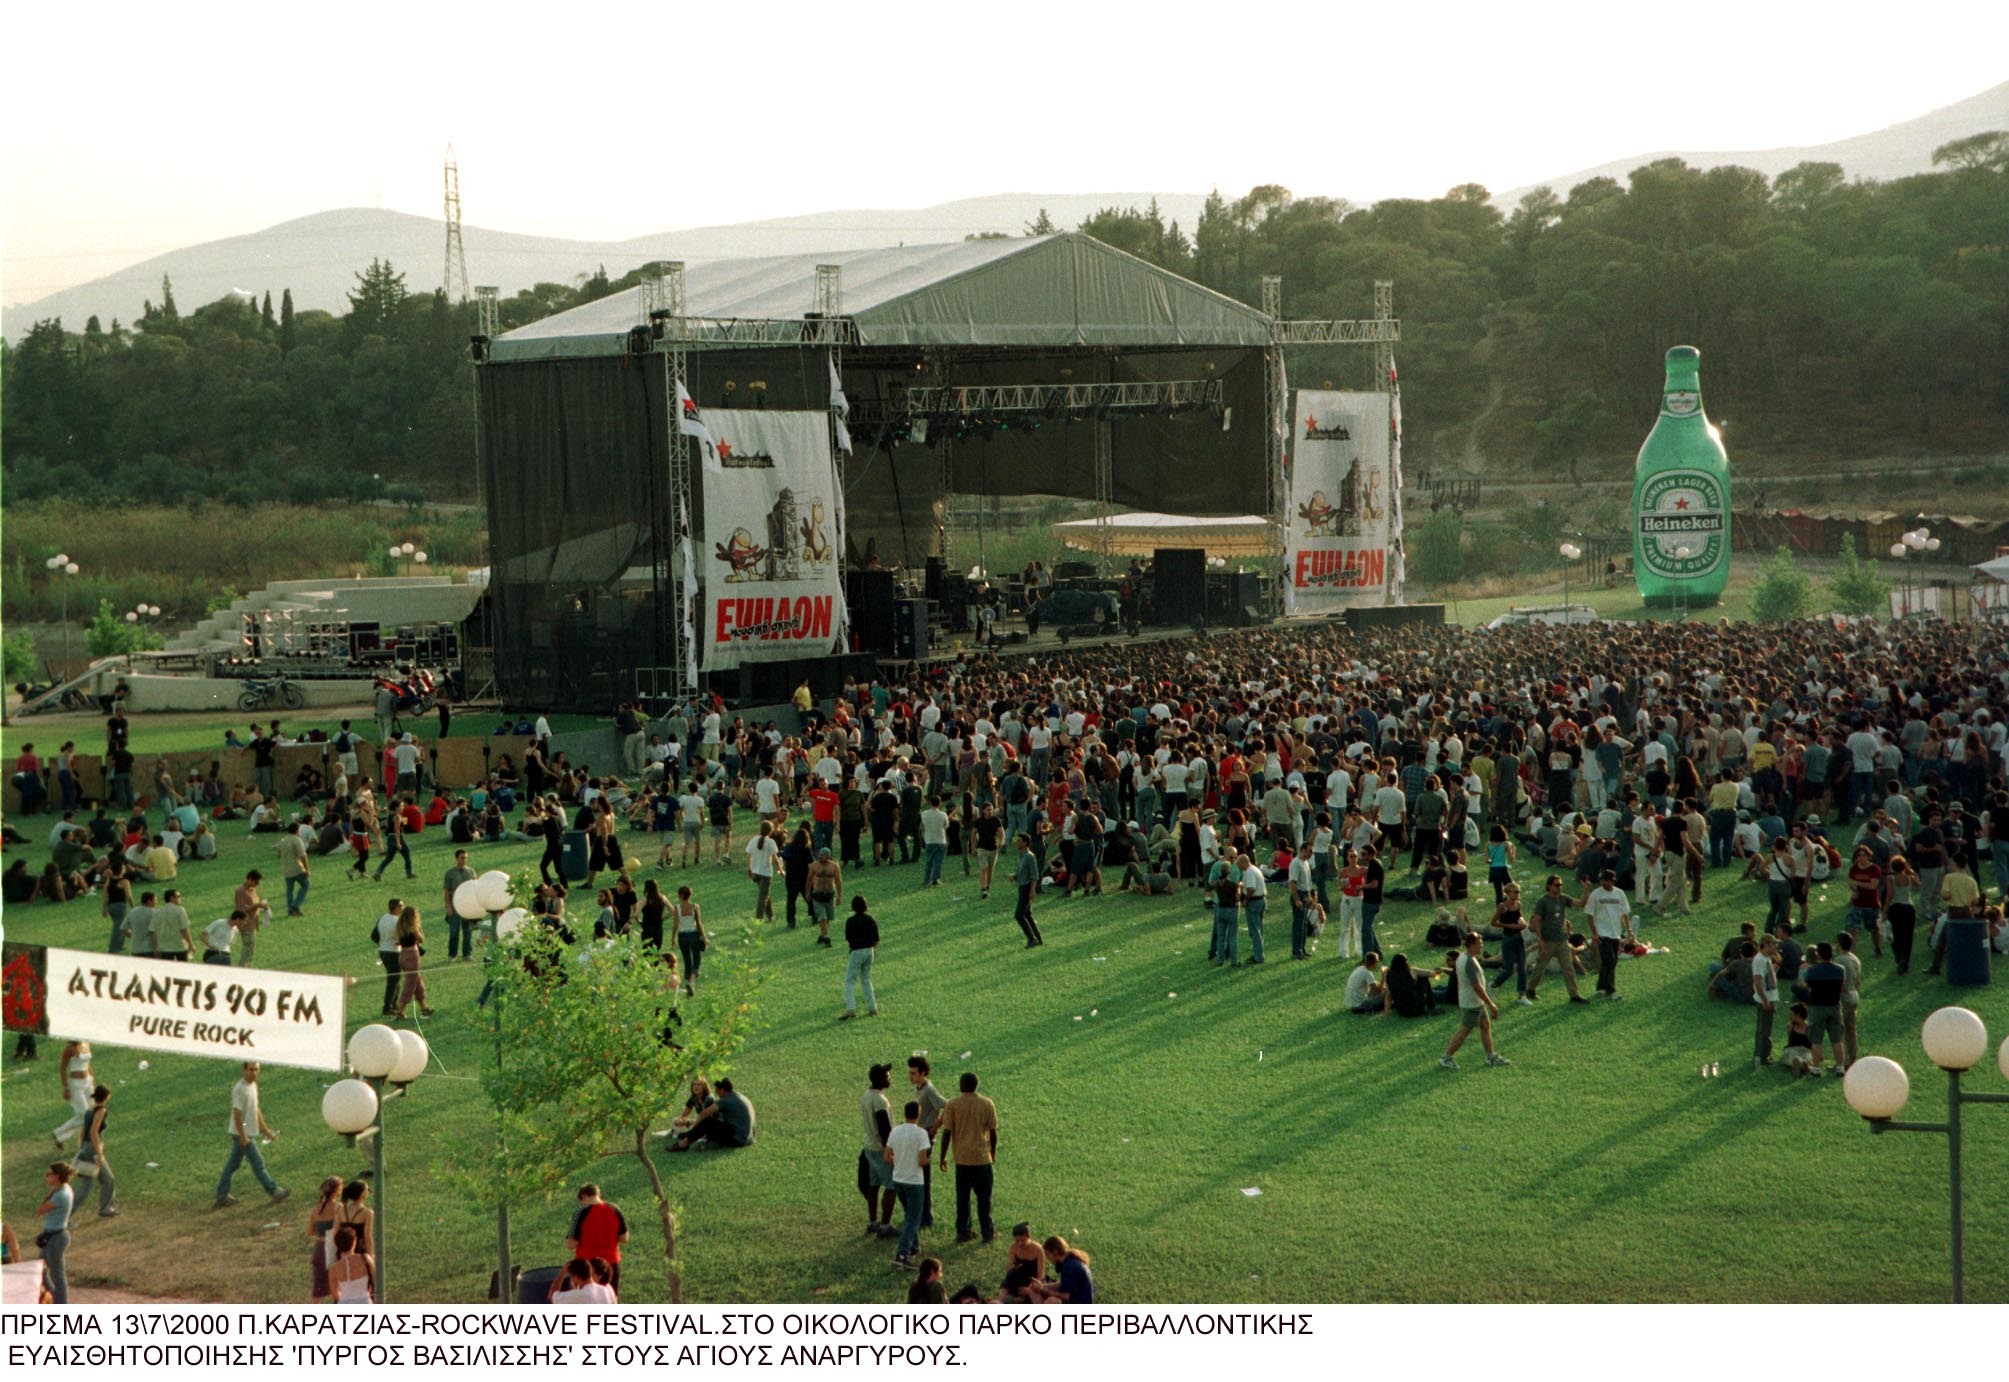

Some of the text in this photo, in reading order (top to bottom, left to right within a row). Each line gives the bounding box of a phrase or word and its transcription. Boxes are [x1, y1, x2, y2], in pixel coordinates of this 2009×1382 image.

[1678, 478, 1706, 490] LAGER
[1644, 517, 1719, 531] Heineken
[1687, 542, 1718, 569] QUALITY
[68, 966, 324, 1026] ATLANTIS 90 FM
[129, 1015, 255, 1047] PURE ROCK
